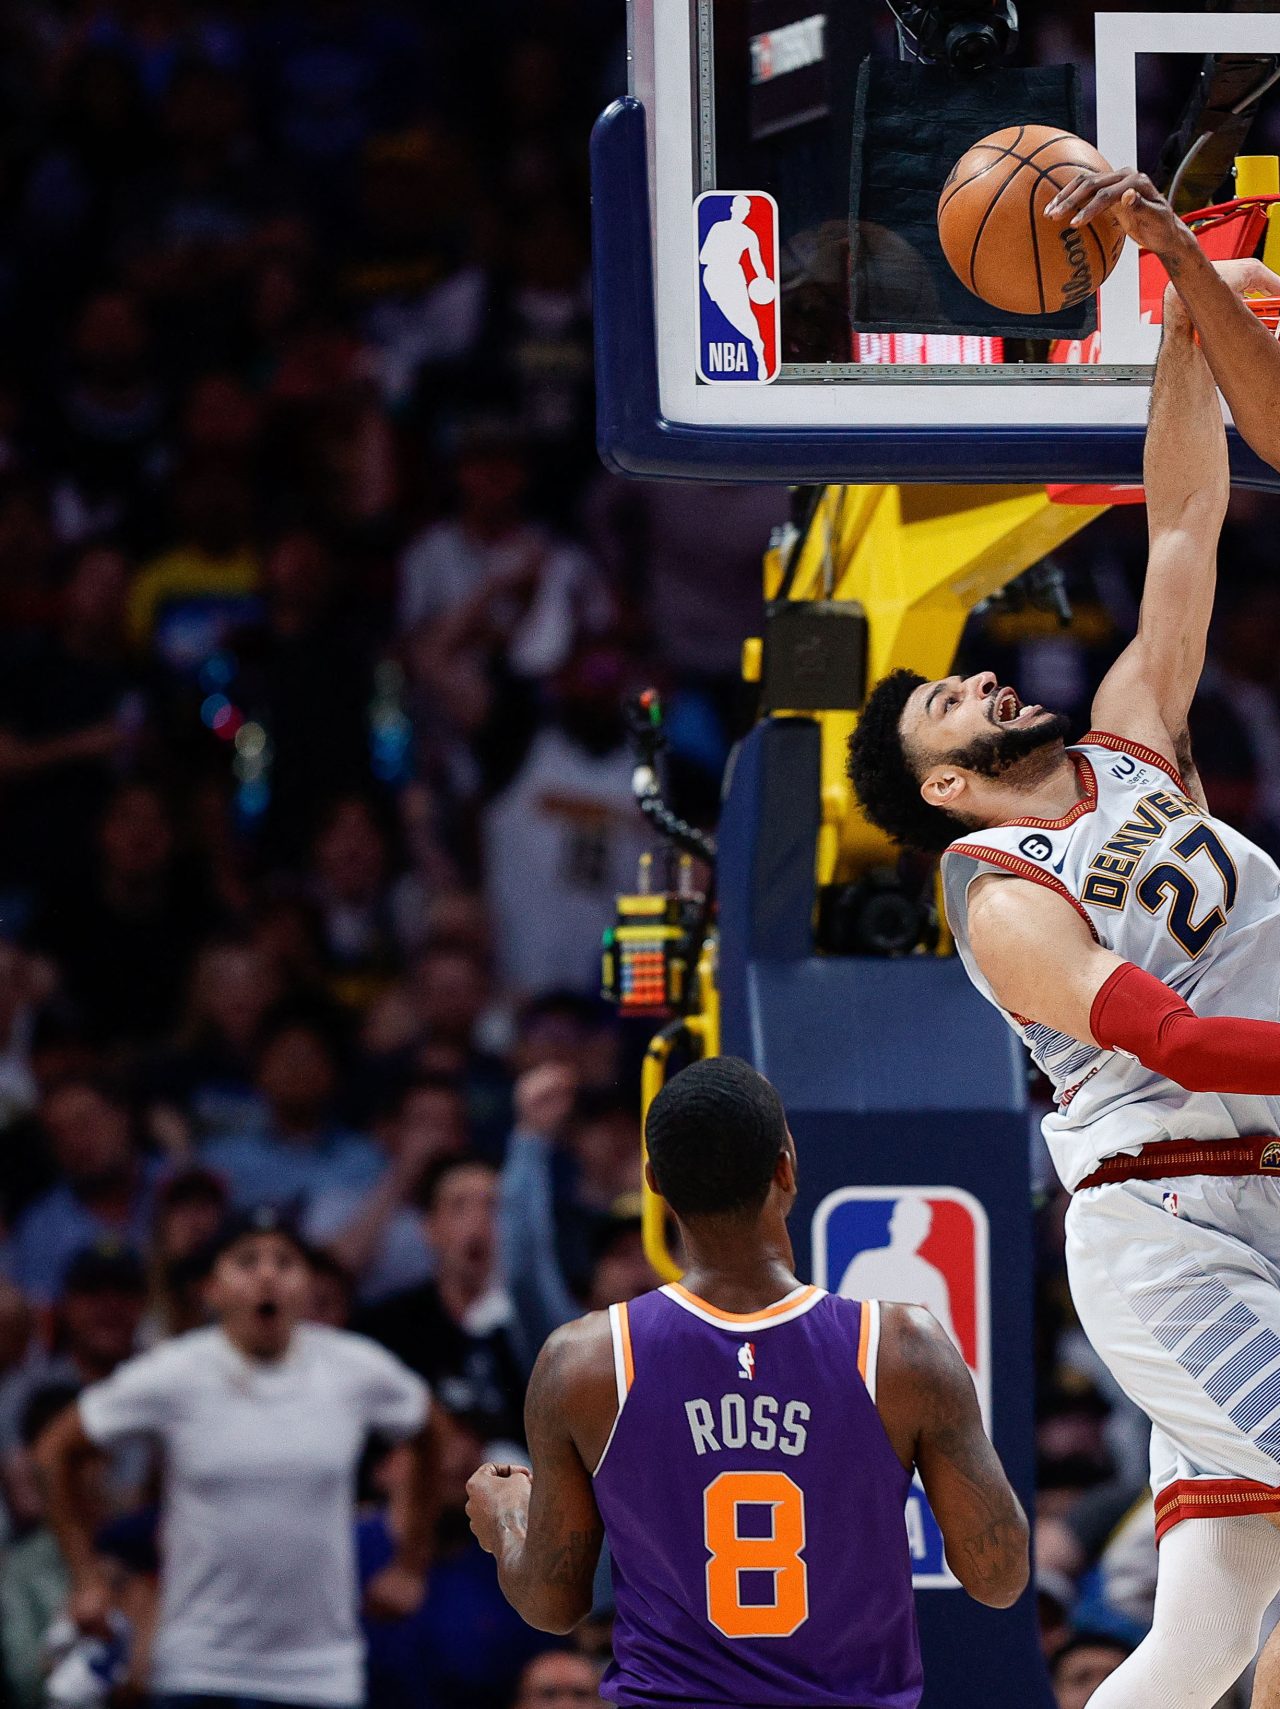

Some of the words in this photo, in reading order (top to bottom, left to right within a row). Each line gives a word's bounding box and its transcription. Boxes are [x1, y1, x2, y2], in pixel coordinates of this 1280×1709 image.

[708, 342, 749, 372] NBA
[1022, 838, 1050, 860] 6
[1136, 820, 1239, 960] 27
[684, 1393, 811, 1456] ROSS
[703, 1471, 809, 1639] 8
